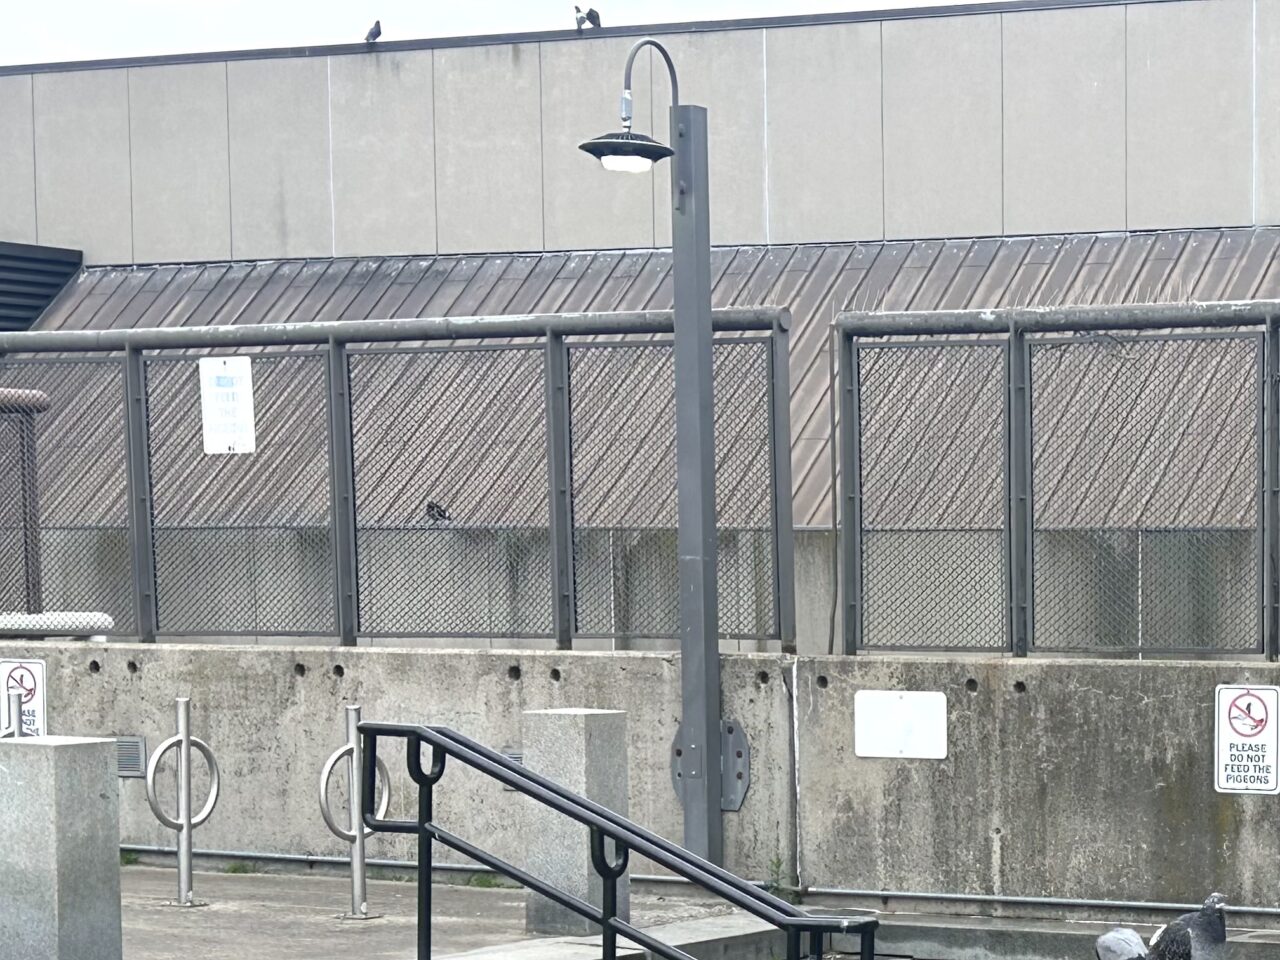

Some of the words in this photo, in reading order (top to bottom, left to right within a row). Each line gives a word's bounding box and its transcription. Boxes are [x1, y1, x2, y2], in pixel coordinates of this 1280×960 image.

[1229, 743, 1267, 753] PLEASE
[1230, 753, 1244, 763] DO
[1246, 754, 1266, 763] NOT
[1224, 764, 1250, 773] FEED
[1252, 764, 1272, 774] THE
[1226, 774, 1270, 784] PIGEONS
